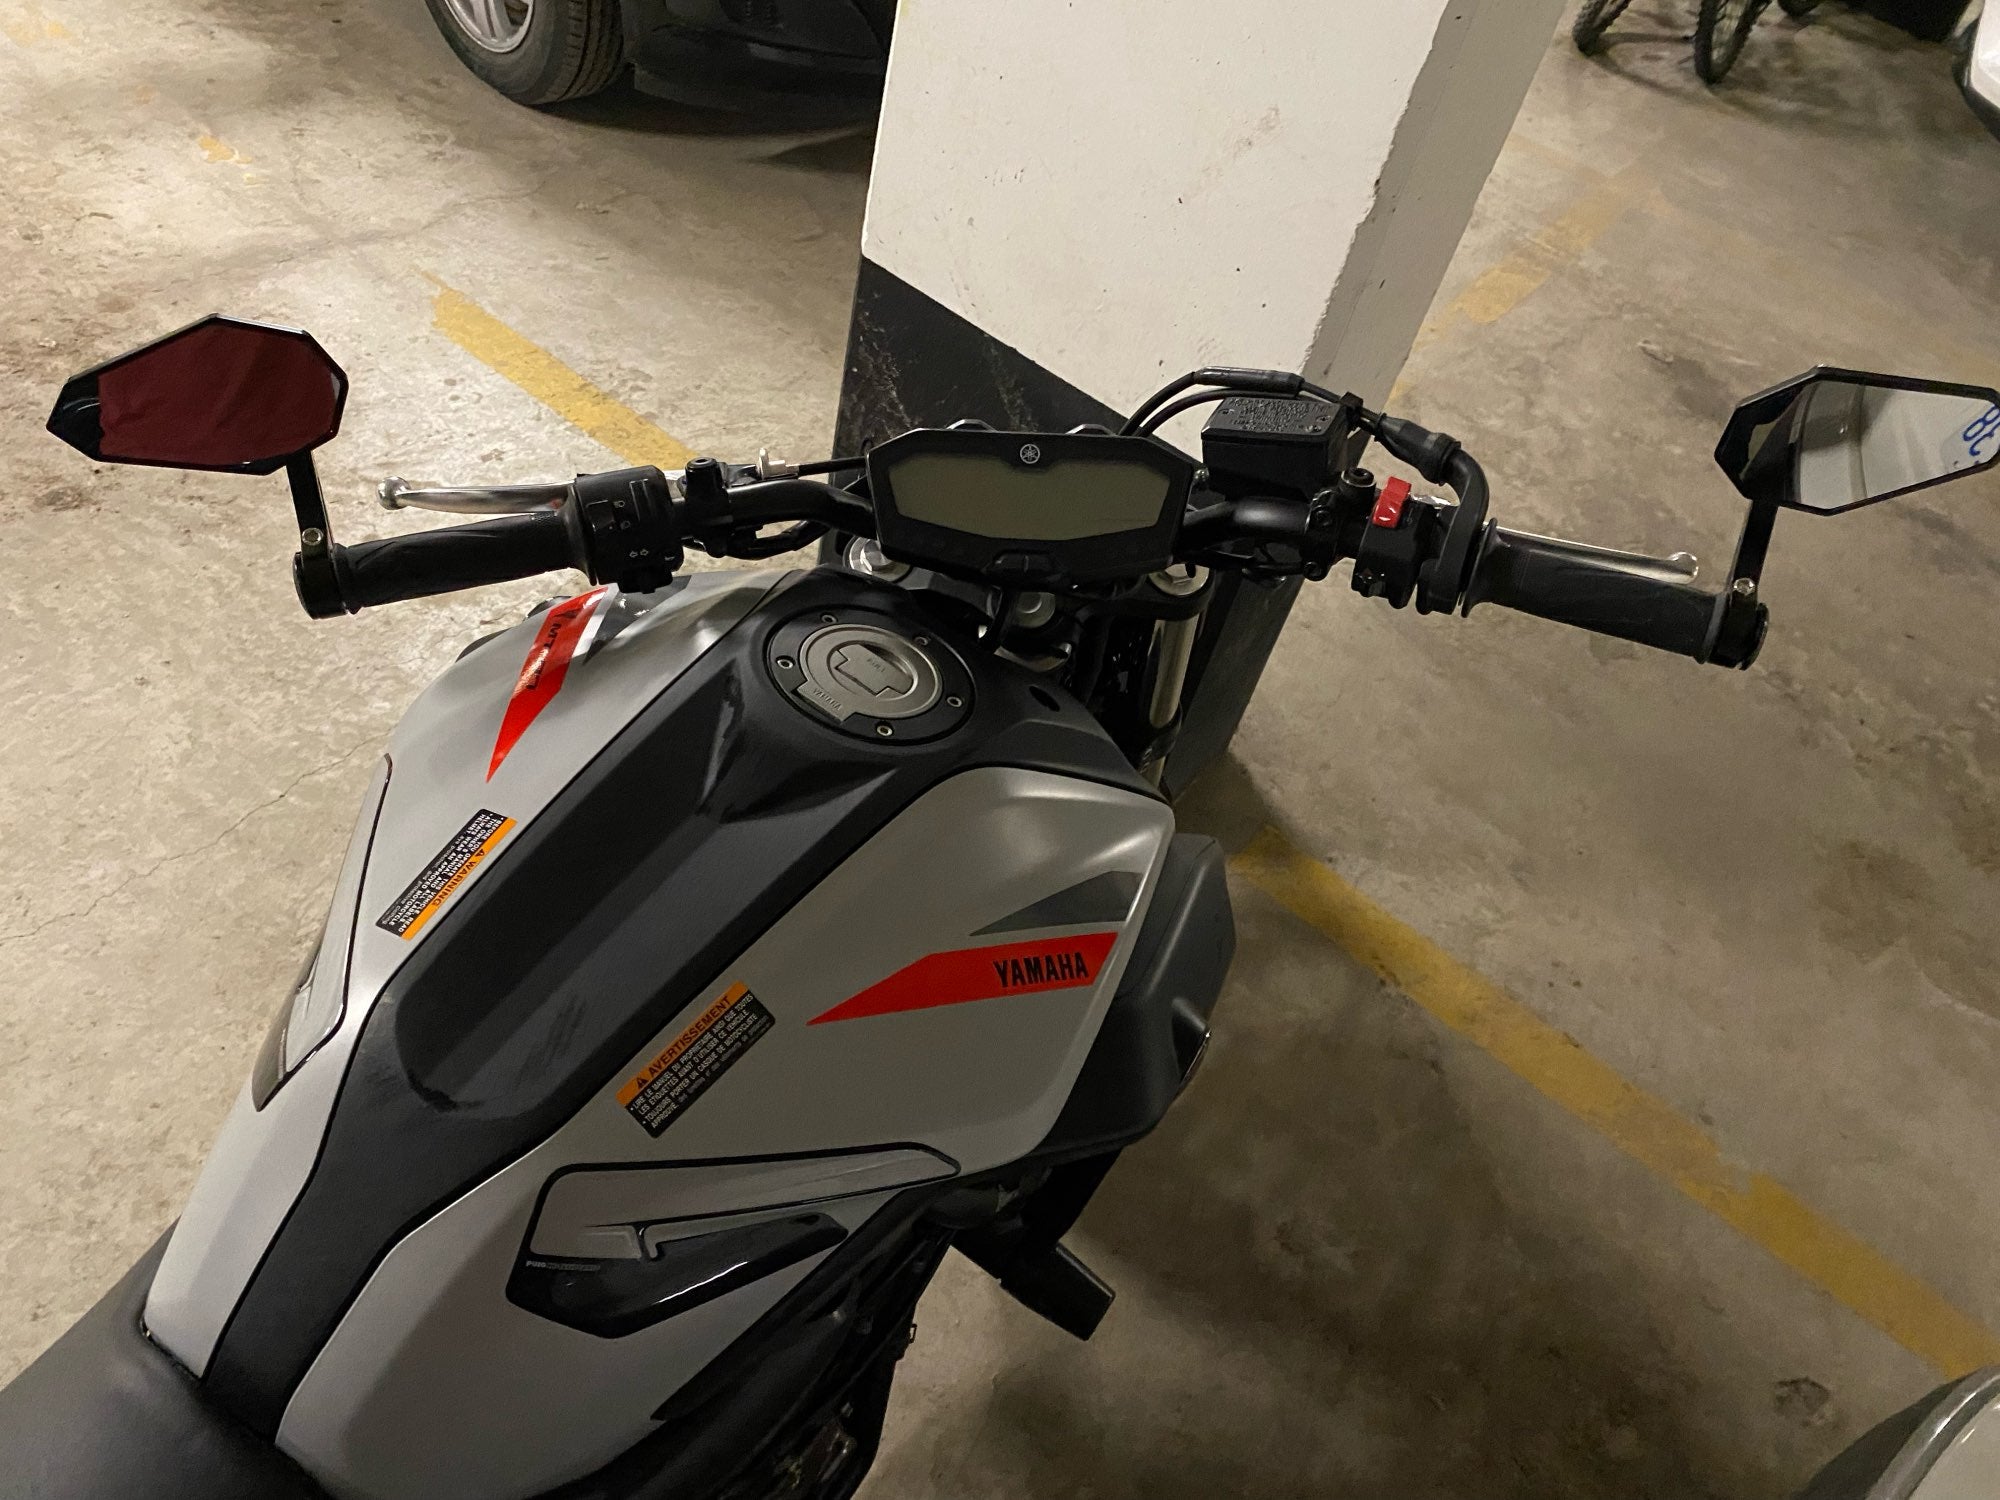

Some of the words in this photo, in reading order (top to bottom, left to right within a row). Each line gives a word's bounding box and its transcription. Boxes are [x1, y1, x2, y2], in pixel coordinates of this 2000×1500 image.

[469, 815, 491, 835] ALWAYS
[480, 819, 502, 840] BEFORE
[484, 817, 496, 828] THE
[455, 835, 472, 851] WEAR
[469, 840, 483, 852] YOU
[440, 853, 464, 875] MANUAL
[446, 851, 457, 860] AN
[446, 852, 472, 877] OPERATE
[420, 861, 449, 889] APPROVED
[429, 876, 442, 888] AND
[430, 860, 476, 906] WARNING
[434, 877, 449, 890] THIS
[418, 889, 431, 900] ALL
[387, 889, 423, 925] MOTORCYCLE
[396, 916, 414, 932] READ
[992, 952, 1090, 988] YAMAHA
[648, 995, 731, 1075] AVERTISSEMENT
[631, 1095, 646, 1109] LIRE
[643, 1087, 653, 1098] LE
[651, 1069, 673, 1091] MANUEL
[670, 1061, 681, 1072] DU
[723, 1009, 737, 1022] QUE
[734, 992, 754, 1012] TOUTES
[637, 1102, 650, 1115] LES
[676, 1060, 694, 1078] AVANT
[717, 1029, 727, 1040] CE
[644, 1095, 672, 1122] TOUJOURS
[669, 1077, 691, 1099] PORTER
[688, 1068, 699, 1080] UN
[696, 1050, 718, 1072] CASQUE
[715, 1043, 726, 1054] DE
[723, 1012, 758, 1047] MOTOCYCLISTE
